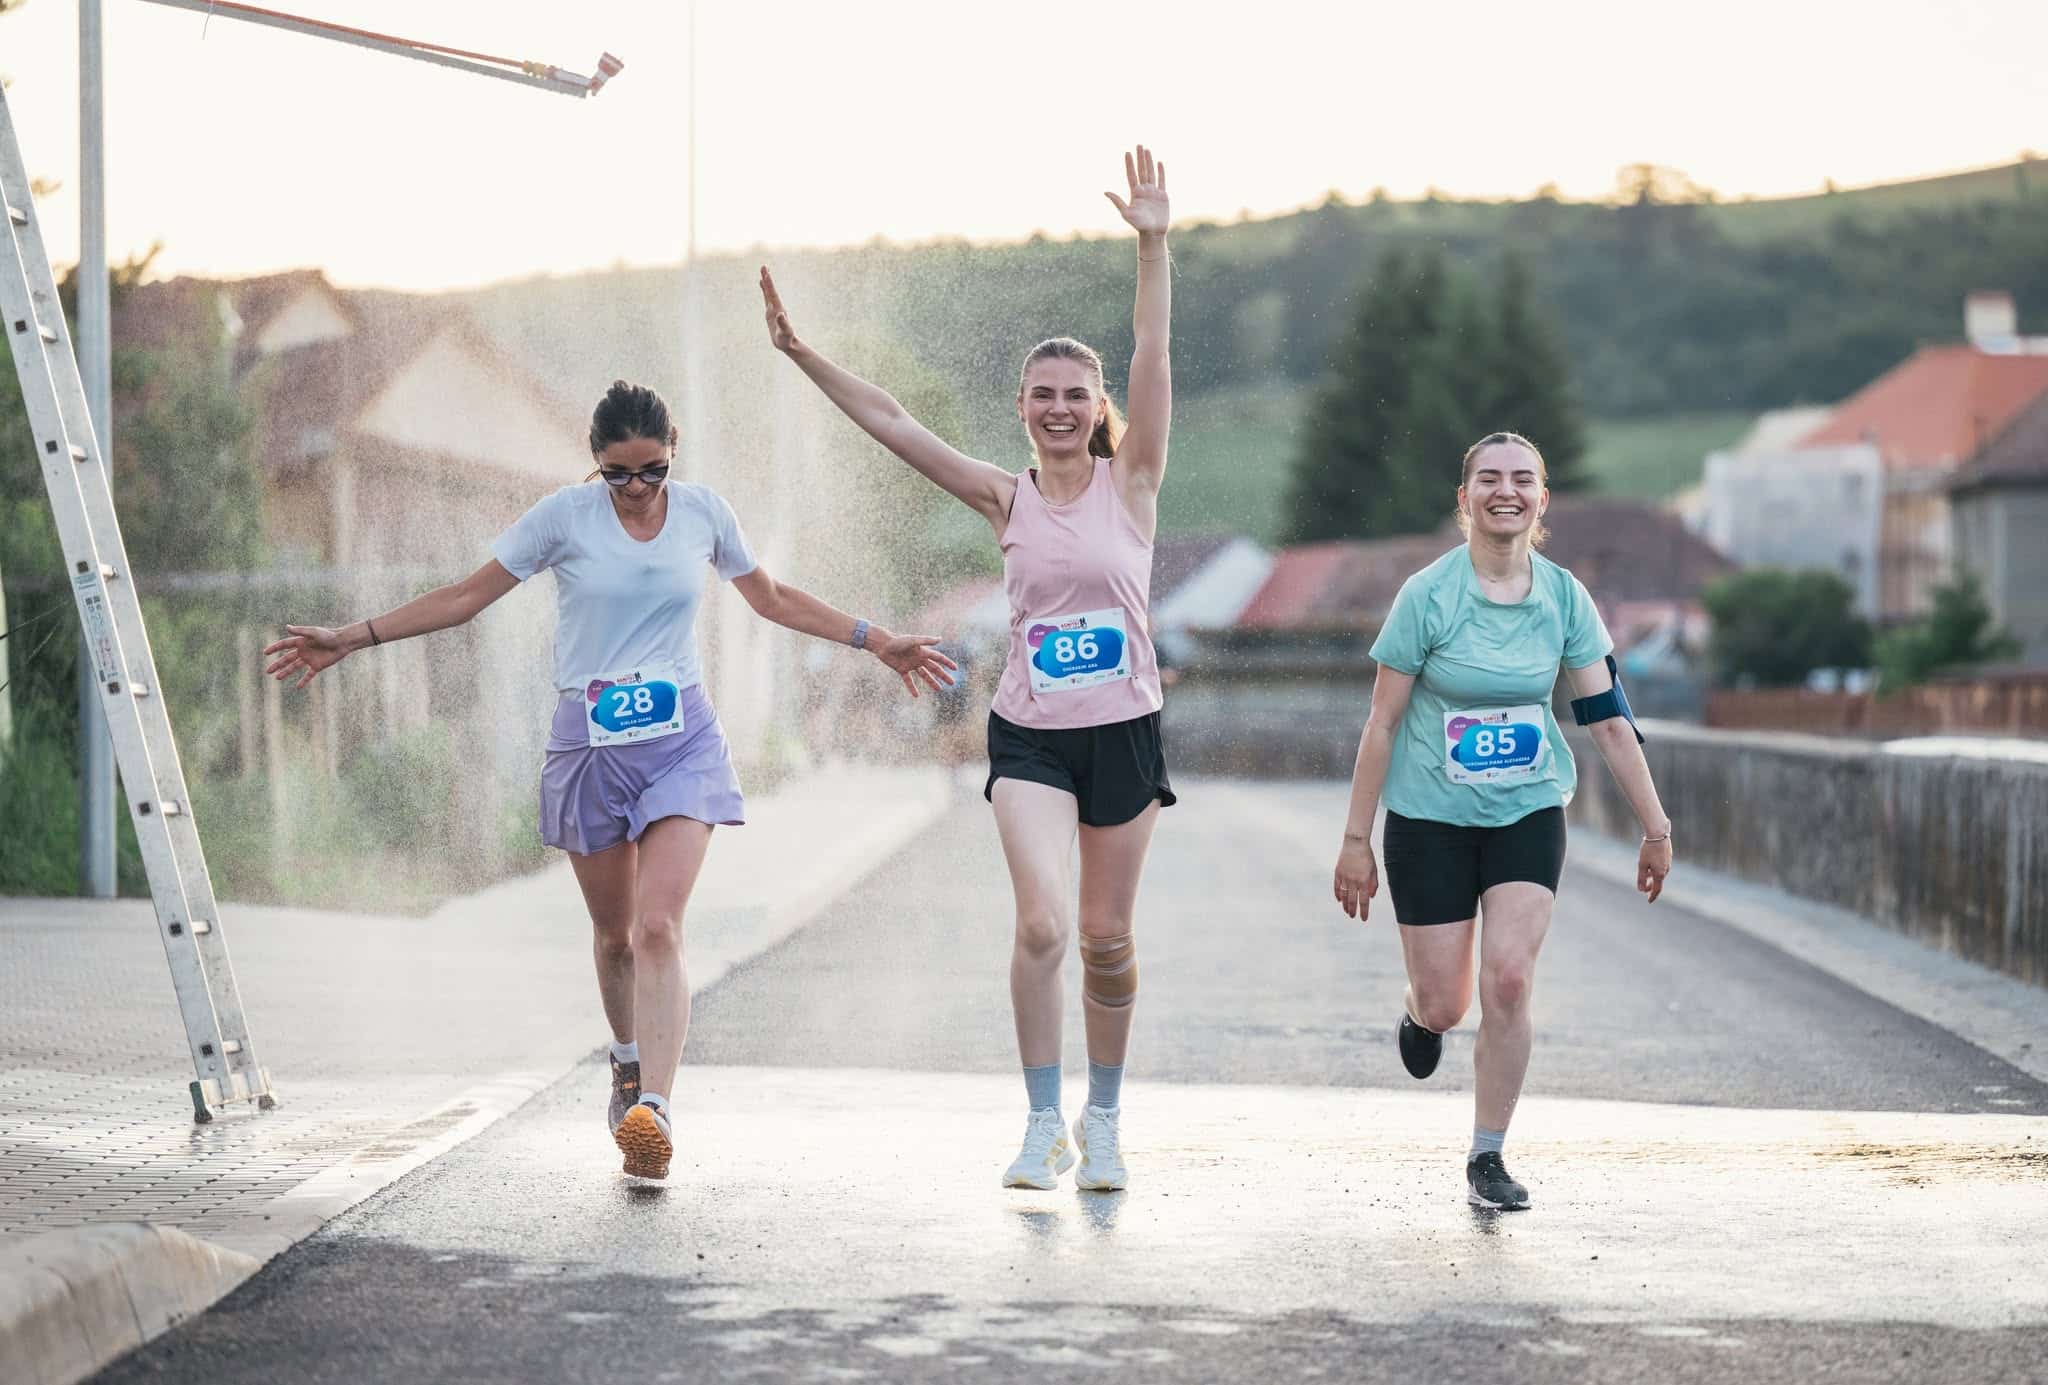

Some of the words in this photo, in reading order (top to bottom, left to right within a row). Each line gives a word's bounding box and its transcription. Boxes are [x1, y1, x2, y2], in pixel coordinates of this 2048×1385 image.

[1054, 633, 1099, 663] 86
[611, 687, 654, 718] 28
[1475, 728, 1516, 757] 85
